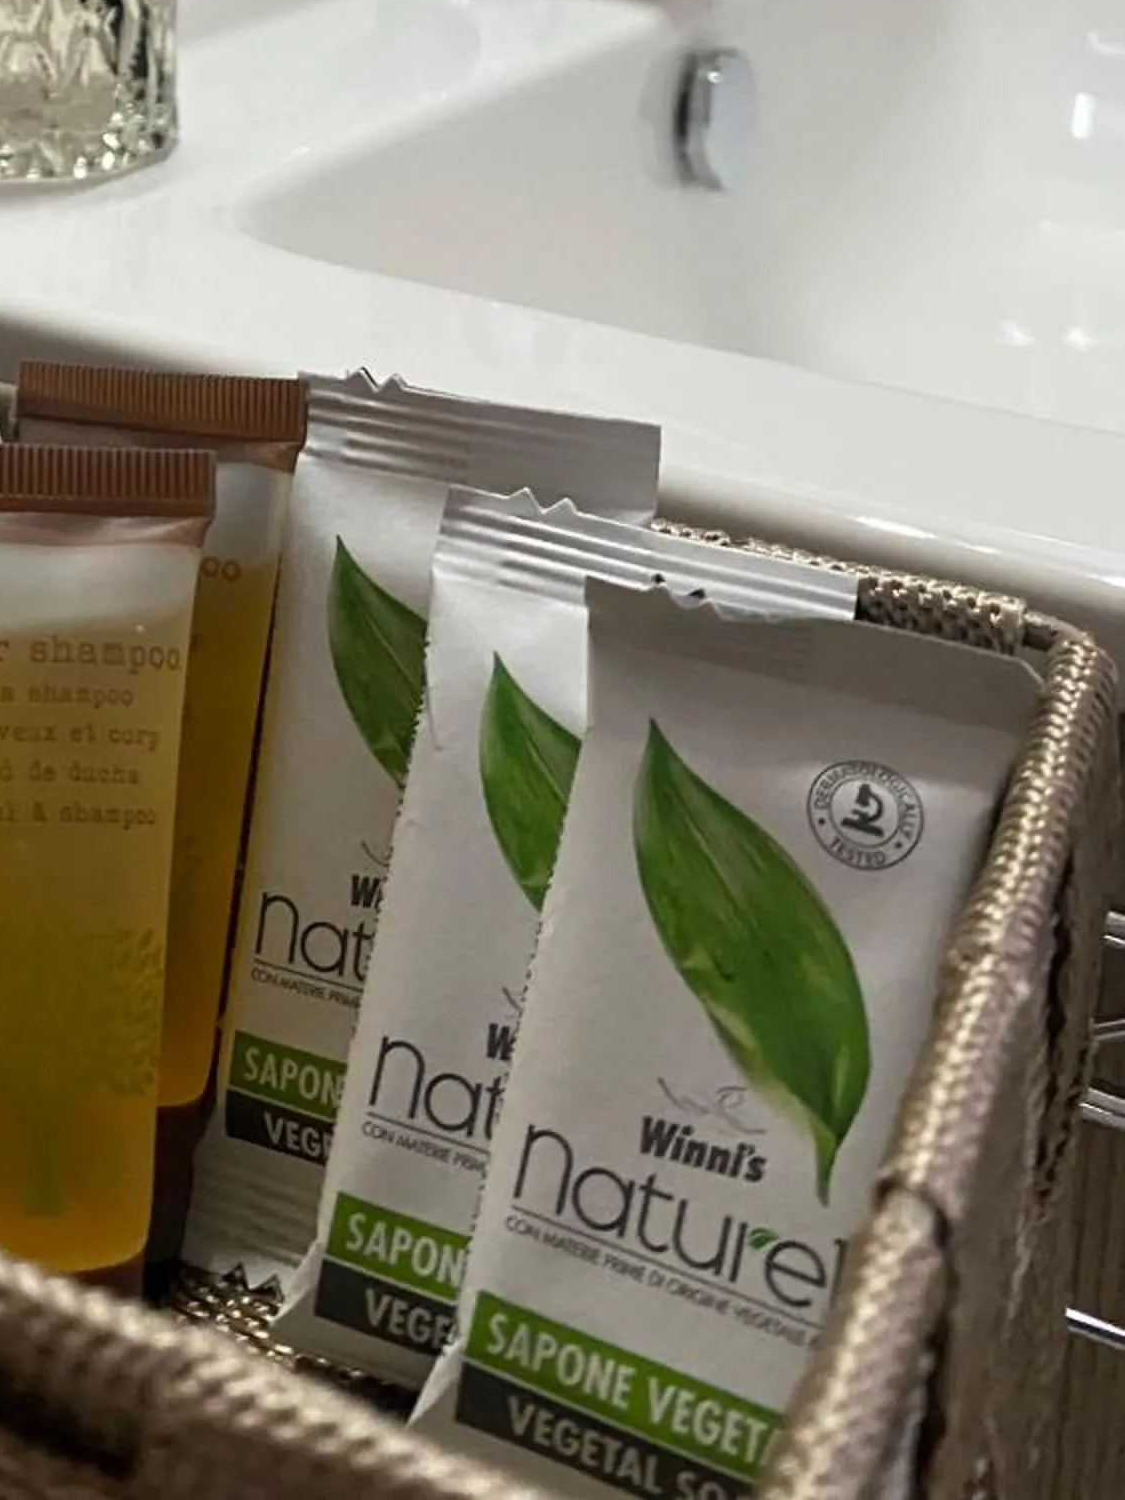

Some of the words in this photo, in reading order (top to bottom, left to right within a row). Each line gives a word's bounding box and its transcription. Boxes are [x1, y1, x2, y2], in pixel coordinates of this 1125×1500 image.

[28, 634, 184, 675] shampoo
[27, 681, 135, 709] shampoo
[69, 722, 97, 743] et
[28, 759, 57, 783] de
[67, 759, 141, 785] ducha
[829, 835, 887, 868] TESTED
[638, 1115, 768, 1184] Winni's
[345, 1211, 465, 1289] SAPON
[485, 1311, 639, 1413] SAPONE
[506, 1396, 664, 1495] VEGETAL
